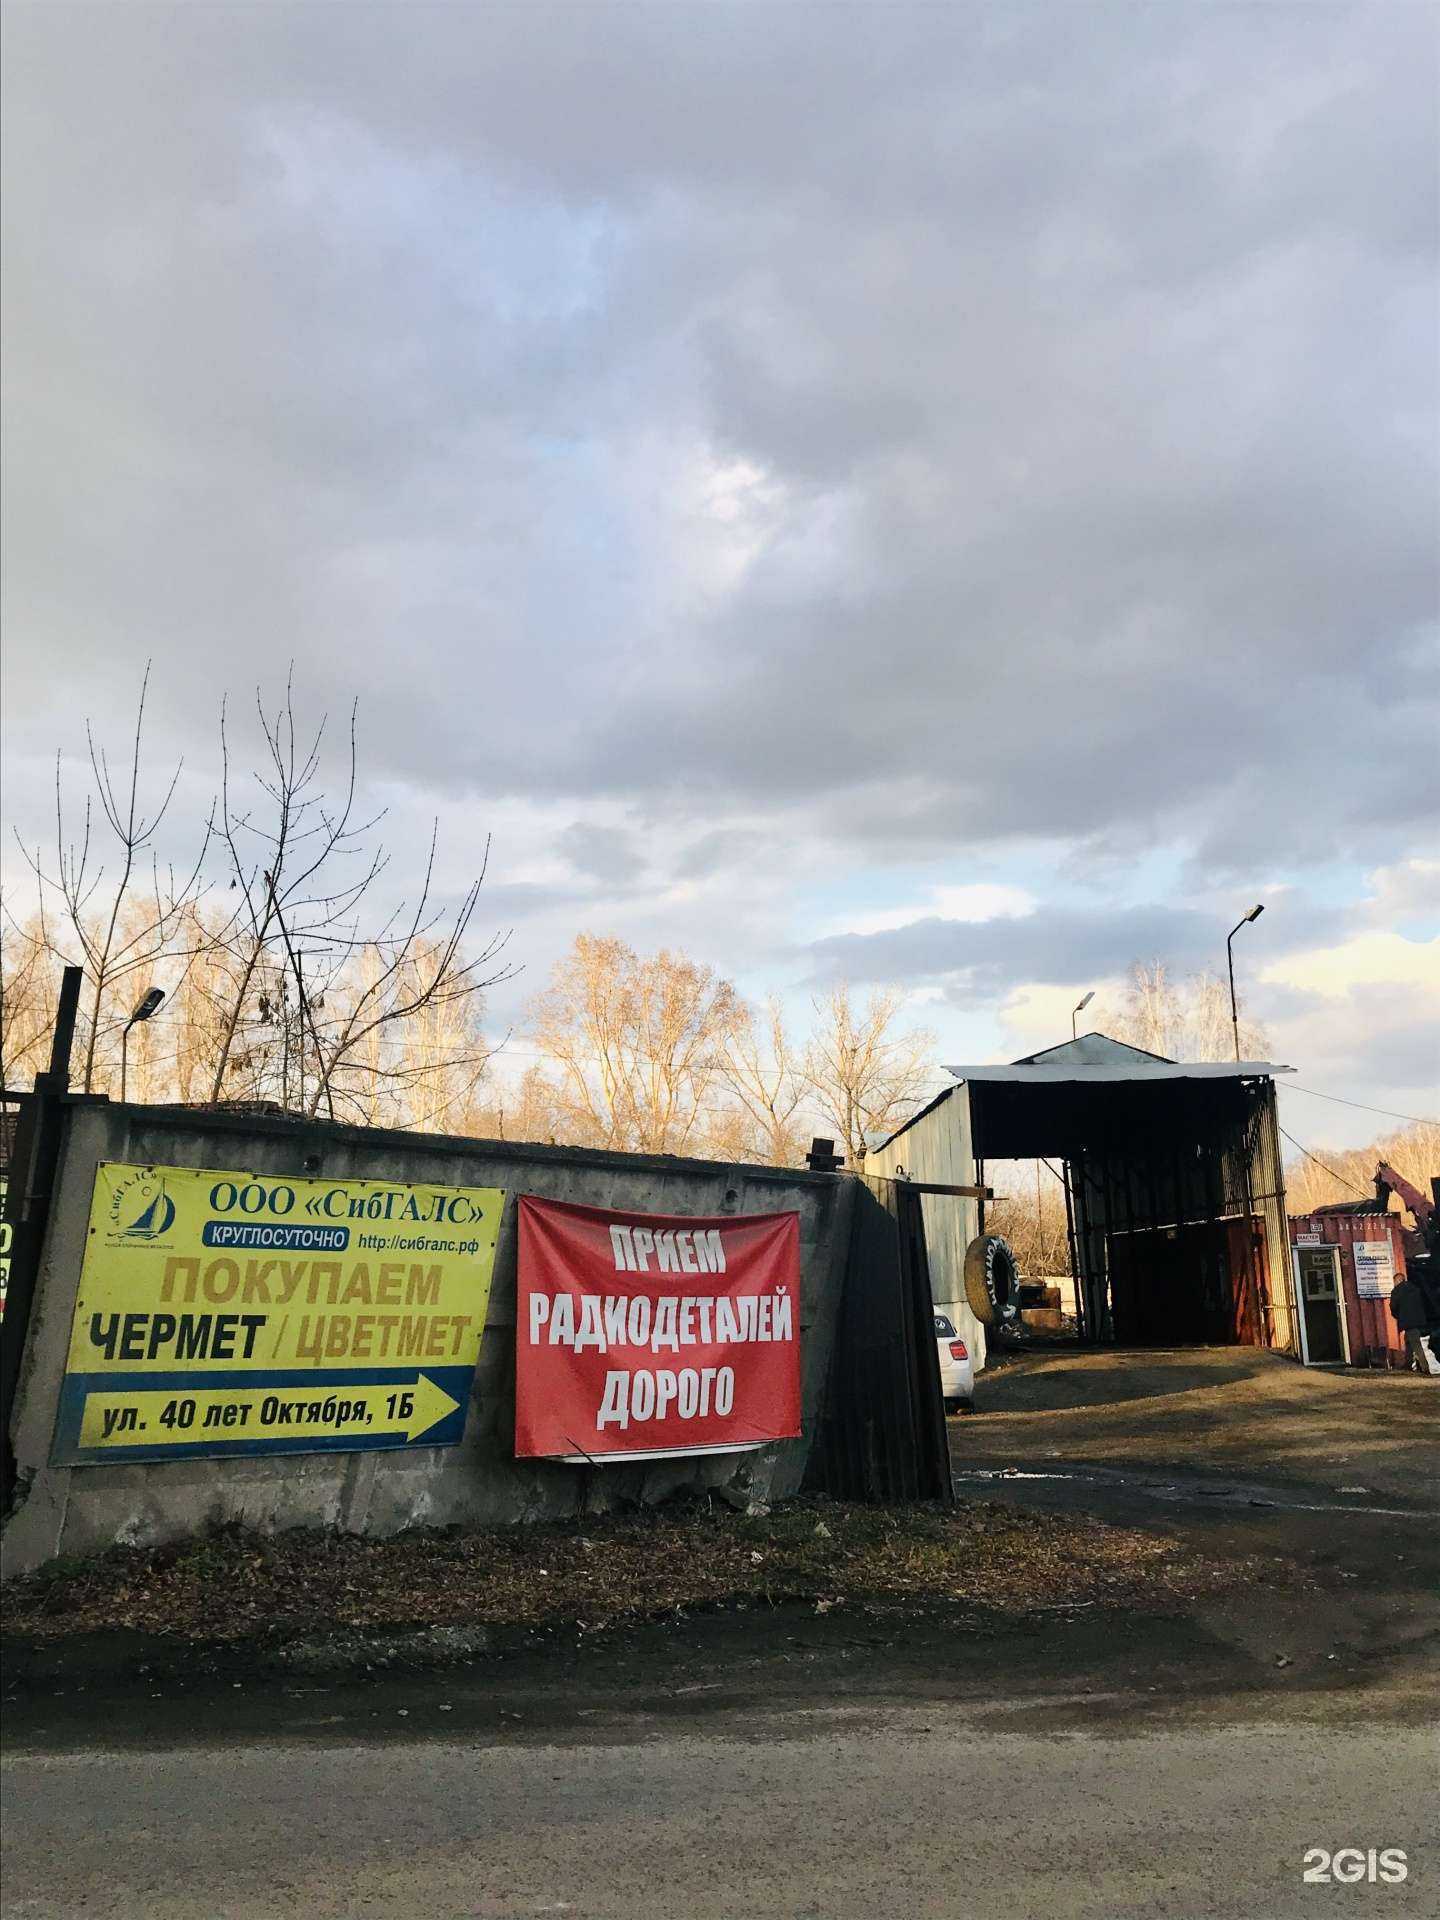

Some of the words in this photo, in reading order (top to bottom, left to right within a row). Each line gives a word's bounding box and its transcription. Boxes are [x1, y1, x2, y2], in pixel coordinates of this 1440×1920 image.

[209, 1182, 296, 1215] ООО
[304, 1189, 484, 1224] «СибГАЛС»
[211, 1225, 346, 1248] КРУГЛОСУТОЧНО
[358, 1233, 480, 1255] http://сибгалс.рф
[608, 1224, 728, 1274] ПРИЕМ
[158, 1256, 444, 1306] ПОКУПАЕМ
[89, 1312, 267, 1361] ЧЕРМЕТ
[295, 1314, 473, 1367] ЦВЕТМЕТ
[529, 1285, 793, 1354] РАДИОДЕТАЛЕЙ
[101, 1406, 147, 1439] ул.
[159, 1399, 196, 1429] 40
[203, 1402, 252, 1428] лет
[259, 1394, 374, 1427] Октября,
[385, 1392, 415, 1420] 1Б
[596, 1366, 735, 1431] ДОРОГО
